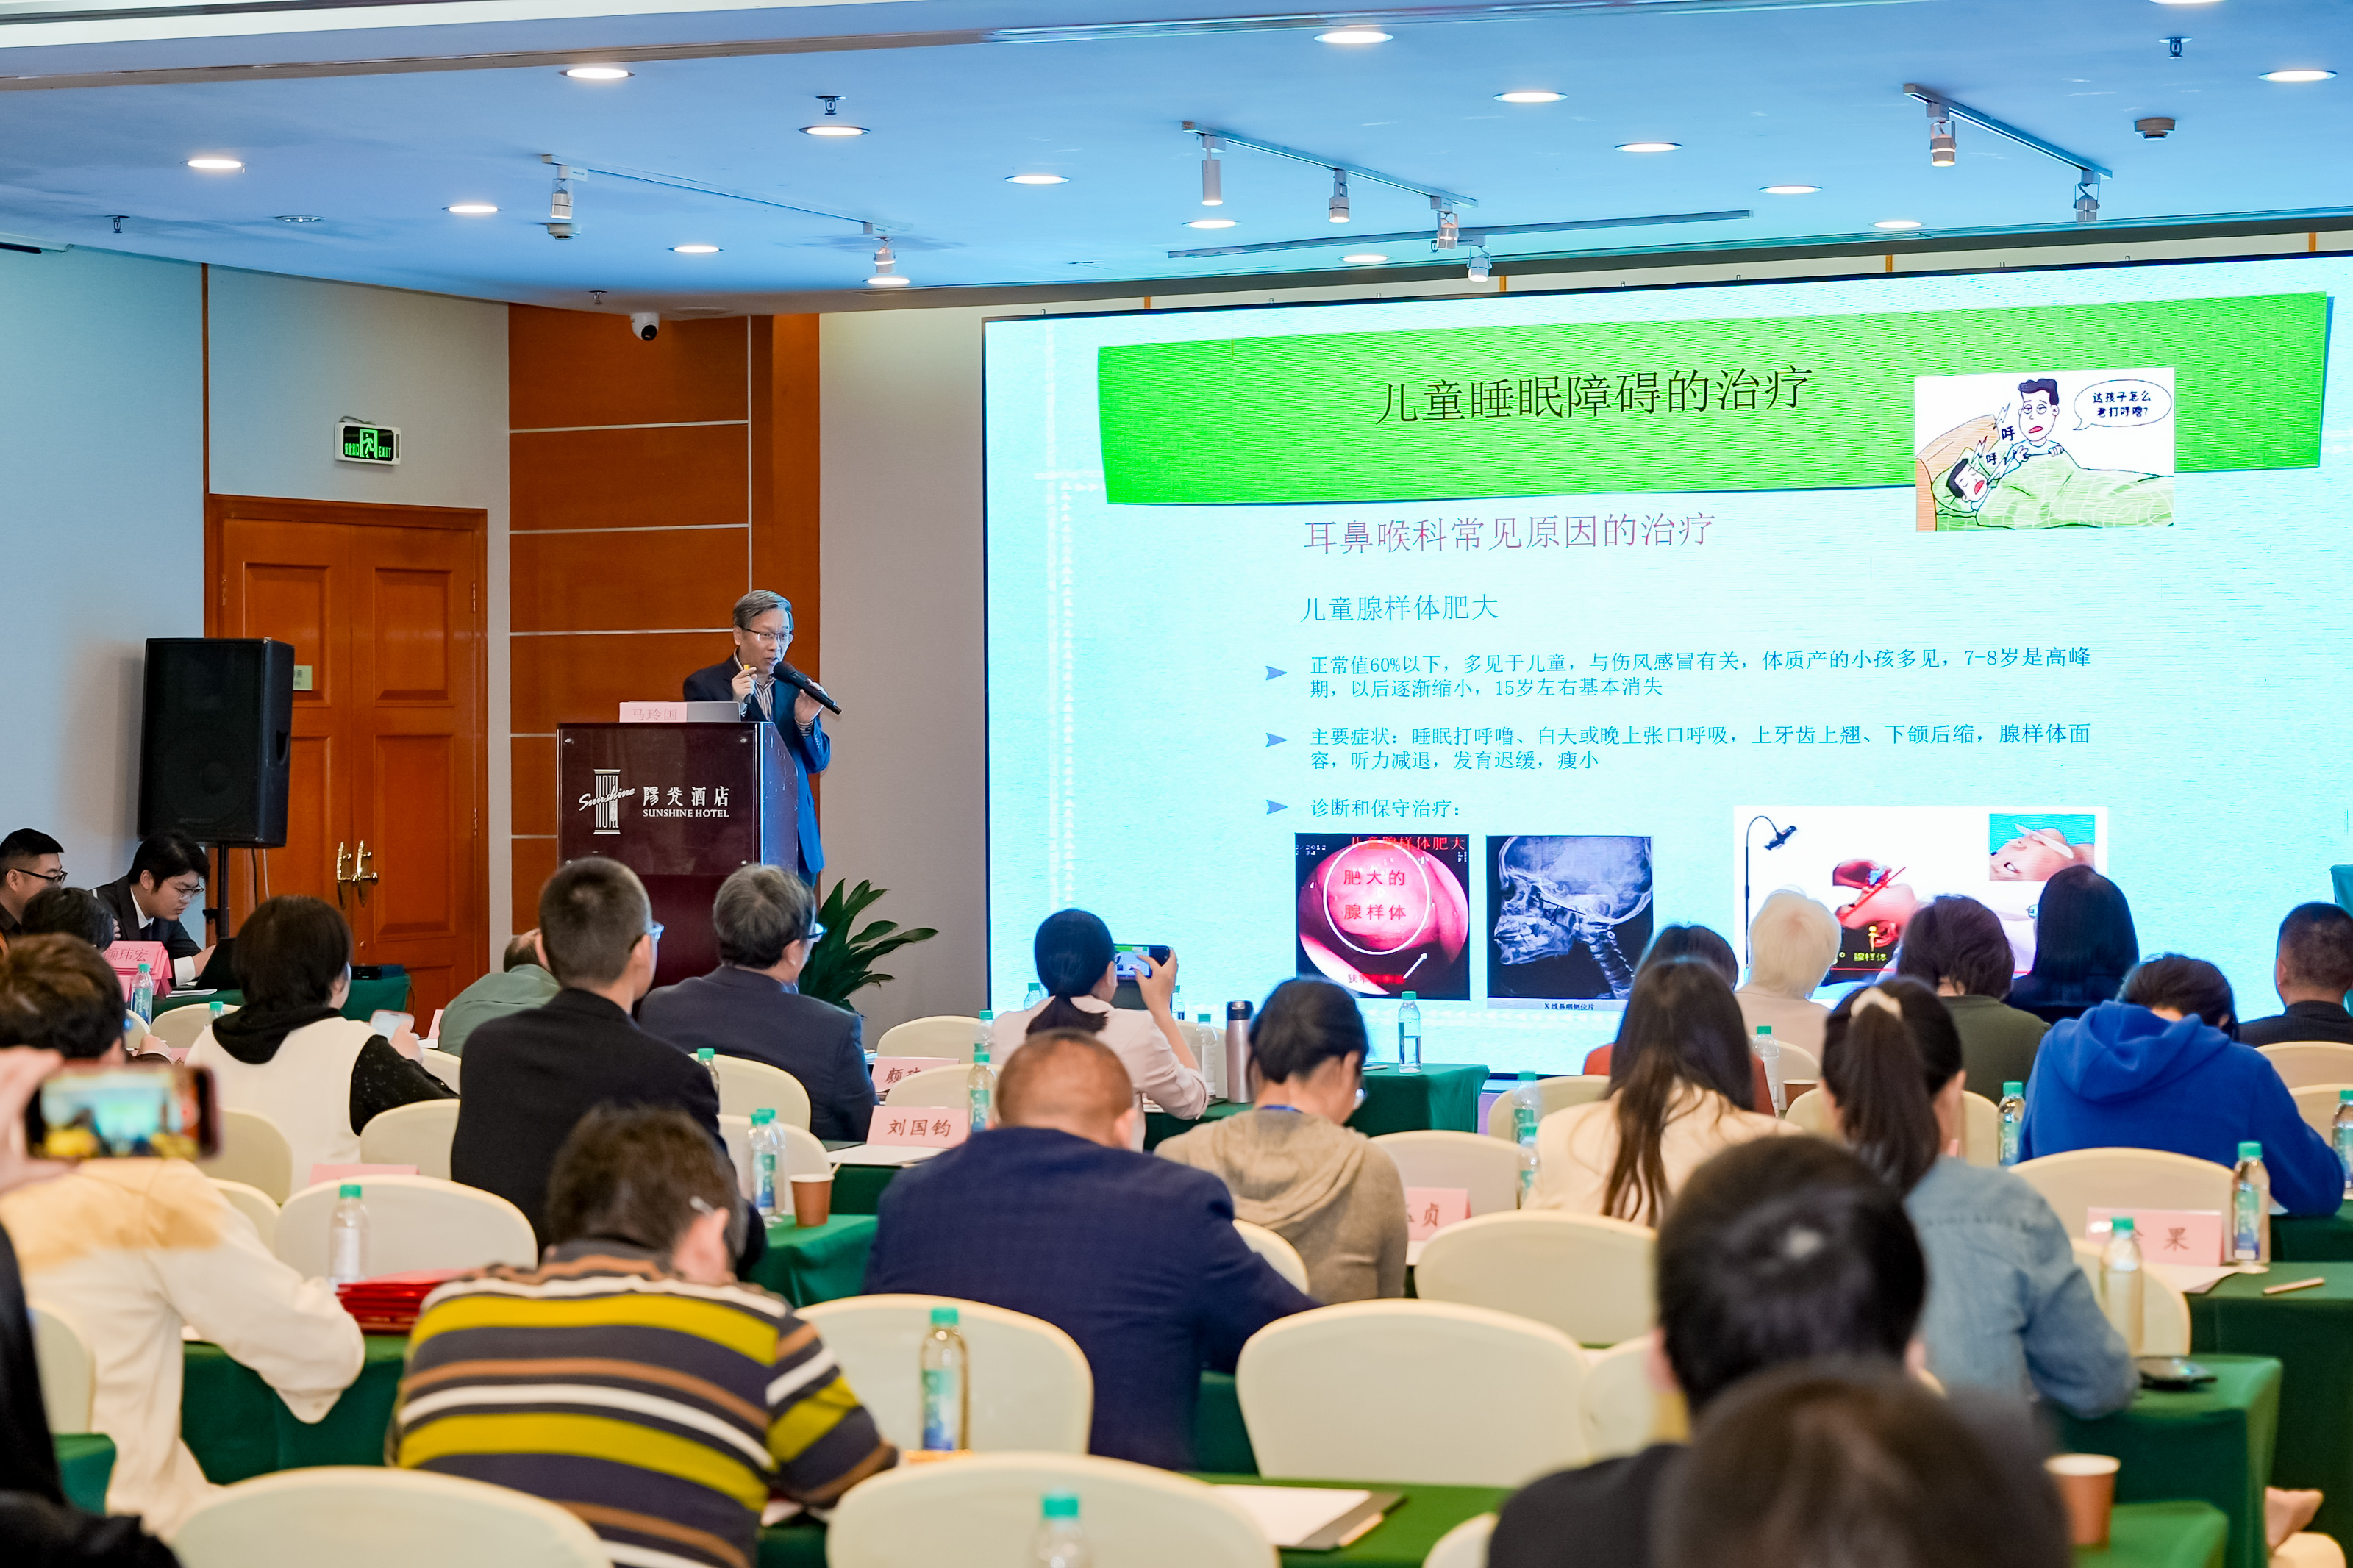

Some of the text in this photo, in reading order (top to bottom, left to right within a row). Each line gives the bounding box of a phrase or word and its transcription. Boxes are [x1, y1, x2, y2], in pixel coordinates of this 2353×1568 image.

[1374, 365, 1813, 425] 儿童睡眠障碍的治疗
[2093, 390, 2152, 404] 这孩子怎么
[378, 446, 392, 458] EXIT
[1302, 511, 1716, 554] 耳鼻喉科常见原因的治疗
[1300, 594, 1499, 623] 儿童腺样体肥大
[630, 707, 678, 722] 马玲国
[579, 785, 635, 811] Sunshine
[643, 809, 729, 817] SUNSHINE HOTEL
[1310, 798, 1461, 817] 诊断和保守治疗：
[1343, 869, 1406, 887] 肥大的
[1343, 903, 1407, 921] 腺样体
[887, 1118, 951, 1138] 刘国钧
